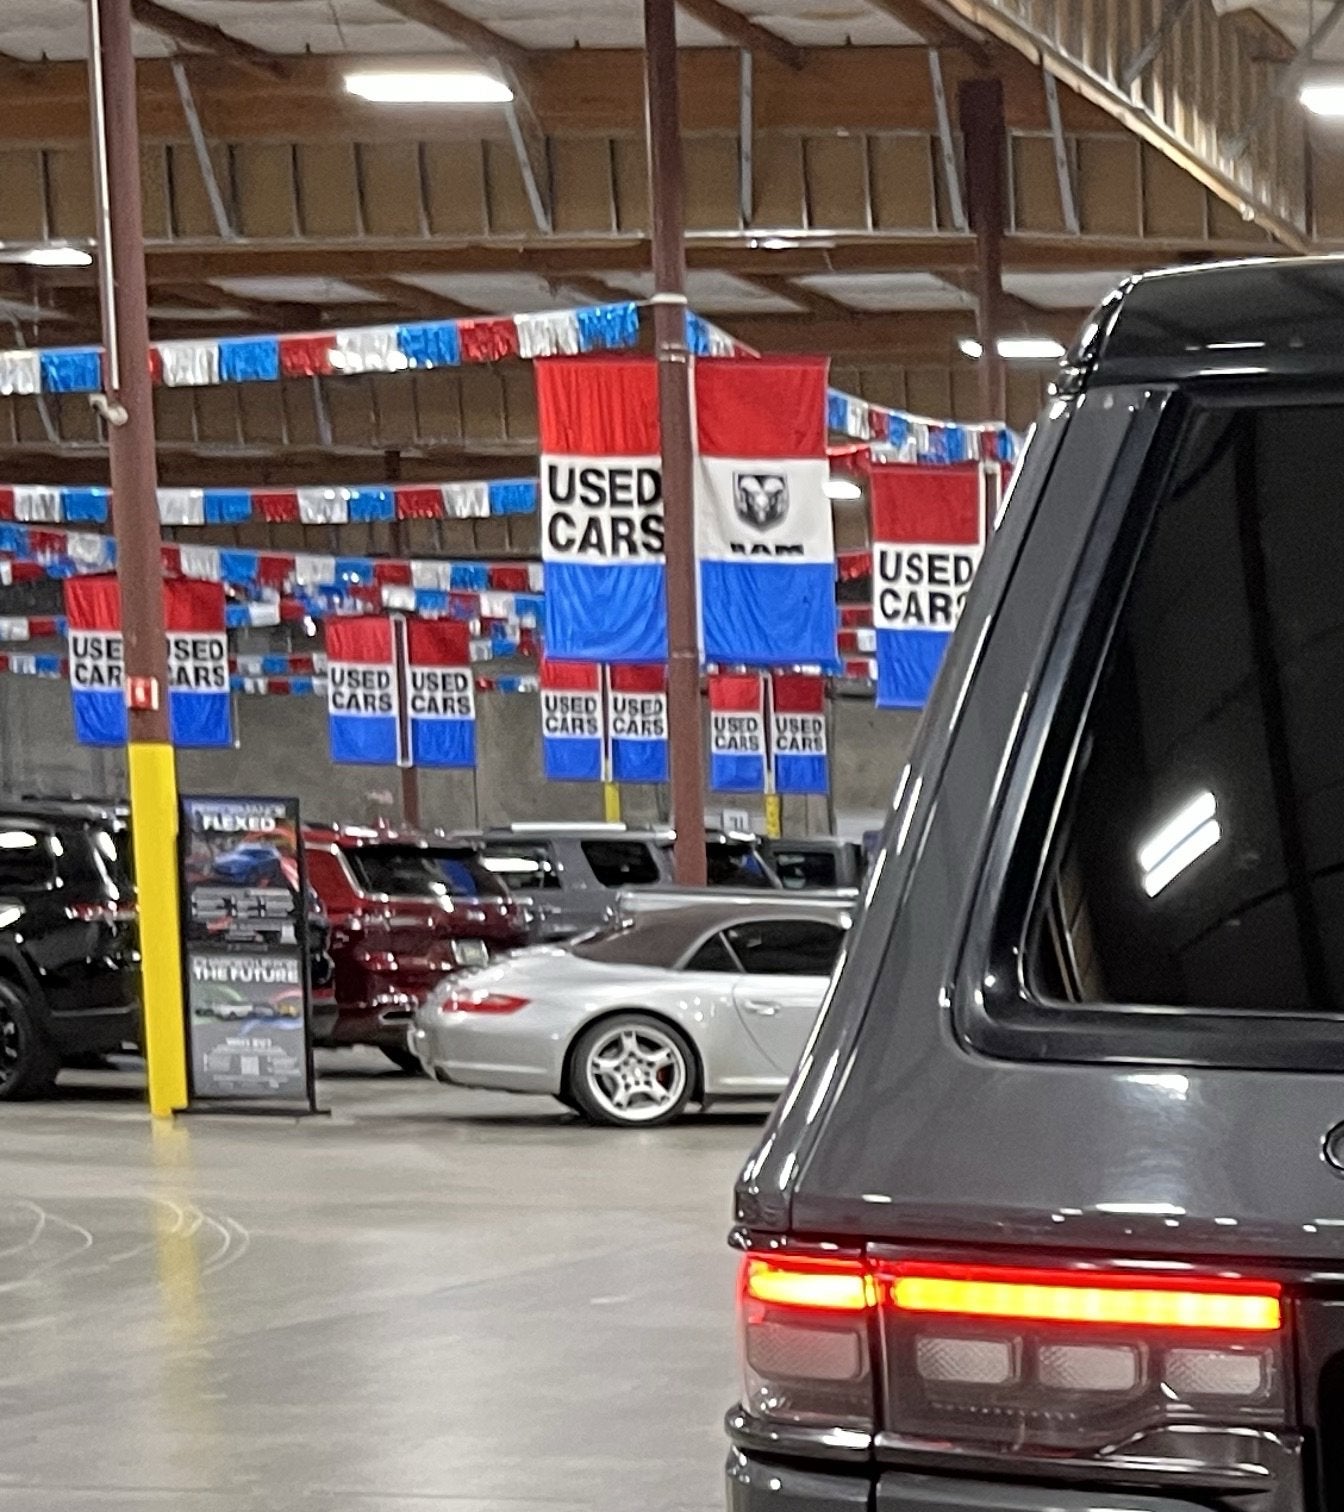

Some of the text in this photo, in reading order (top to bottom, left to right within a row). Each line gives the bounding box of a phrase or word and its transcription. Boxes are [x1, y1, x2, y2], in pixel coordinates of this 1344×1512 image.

[547, 464, 663, 508] USED
[547, 512, 665, 557] CARS
[879, 549, 974, 586] USED
[72, 636, 123, 661] USE
[167, 638, 225, 662] SED
[74, 662, 123, 687] CAR
[167, 664, 226, 688] ARS
[330, 666, 391, 691] USED
[411, 671, 469, 693] USED
[331, 691, 393, 713] CARS
[411, 694, 472, 715] CARS
[544, 695, 597, 715] USED
[612, 696, 663, 716] USED
[545, 716, 598, 735] CARS
[612, 716, 665, 736] CARS
[714, 716, 758, 734] USED
[775, 716, 823, 736] USED
[714, 734, 760, 752] CARS
[775, 734, 824, 752] CARS
